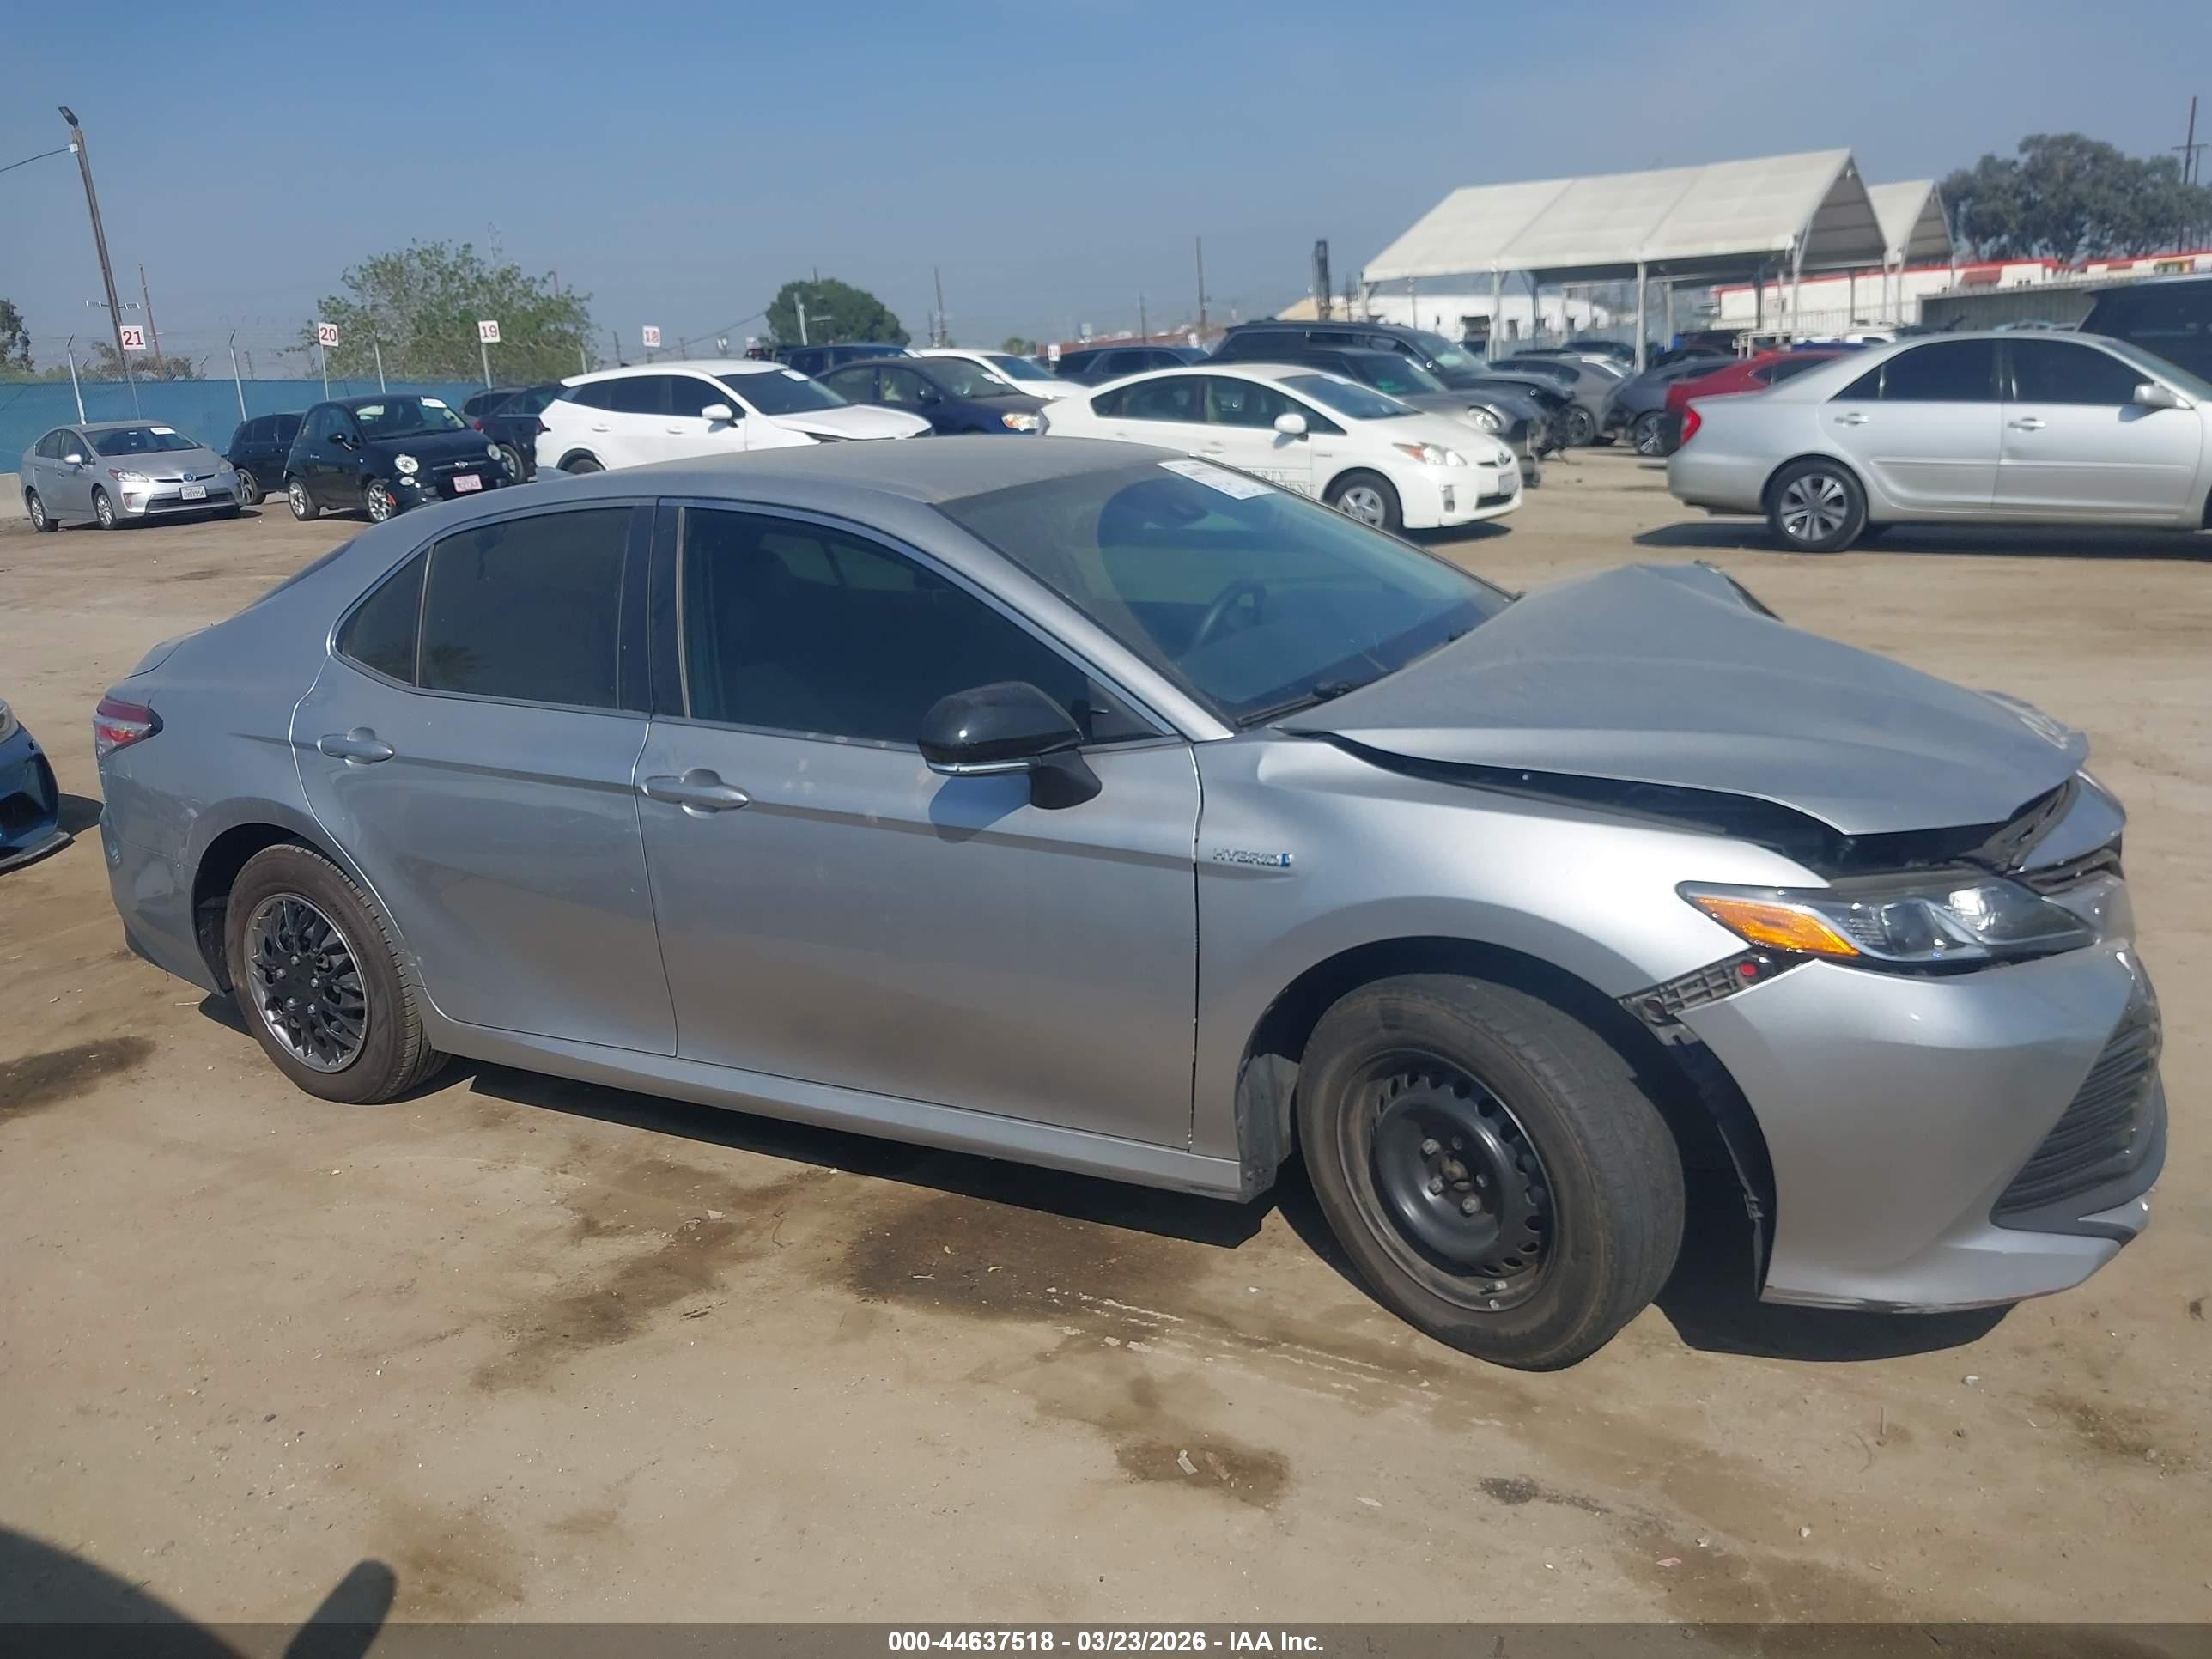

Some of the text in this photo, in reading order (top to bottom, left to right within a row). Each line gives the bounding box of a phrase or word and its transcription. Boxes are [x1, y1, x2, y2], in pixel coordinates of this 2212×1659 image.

[123, 331, 144, 345] 21
[320, 326, 337, 342] 20
[482, 325, 497, 338] 19
[645, 331, 659, 343] 18
[1212, 848, 1279, 866] HYBRID
